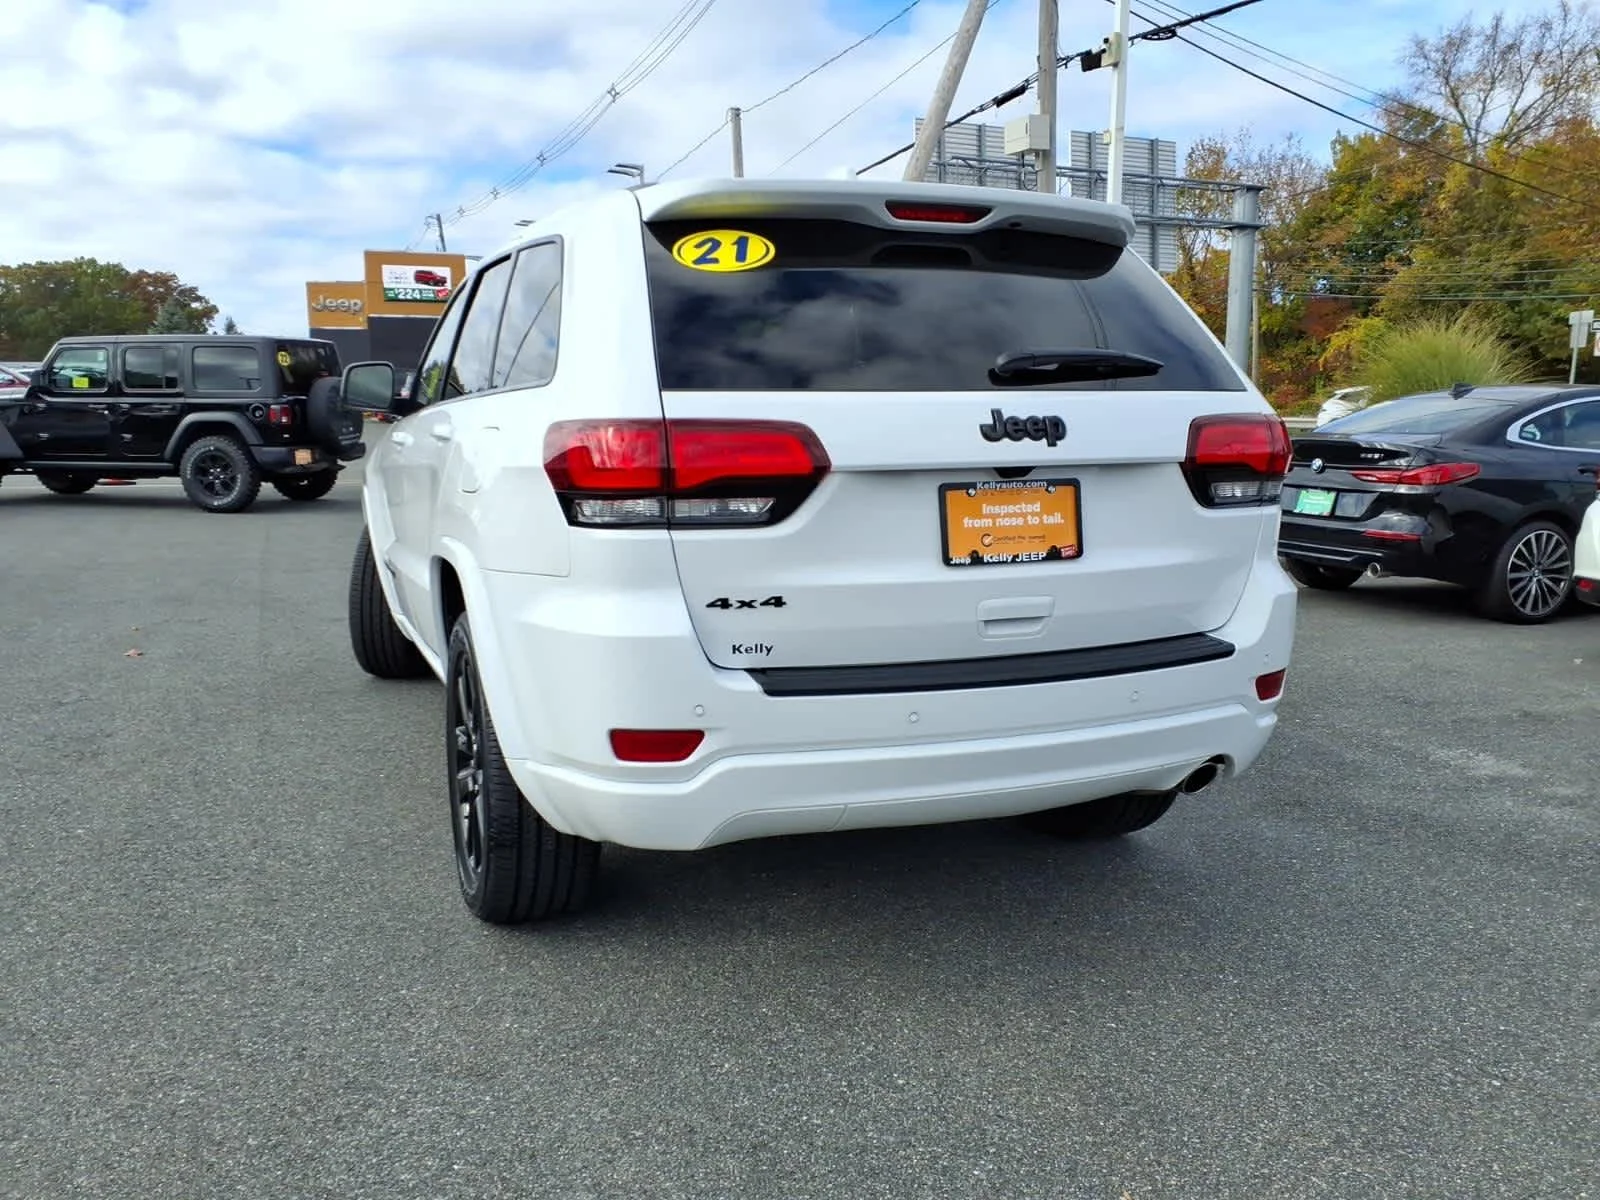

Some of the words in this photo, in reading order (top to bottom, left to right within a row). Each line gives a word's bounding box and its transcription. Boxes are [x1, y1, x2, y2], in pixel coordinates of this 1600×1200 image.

[692, 235, 749, 265] 21
[311, 295, 363, 315] Jeep
[979, 408, 1067, 447] Jeep
[976, 480, 1047, 491] Kellyauto.com
[982, 502, 1041, 516] Inspected
[963, 517, 993, 528] from
[995, 515, 1025, 527] nose
[1026, 514, 1040, 525] to
[1042, 511, 1065, 525] tail.
[950, 557, 972, 565] Jeep
[983, 554, 1014, 564] Kelly
[1016, 551, 1046, 562] JEEP
[705, 596, 787, 610] 4x4
[731, 643, 774, 657] Kelly
